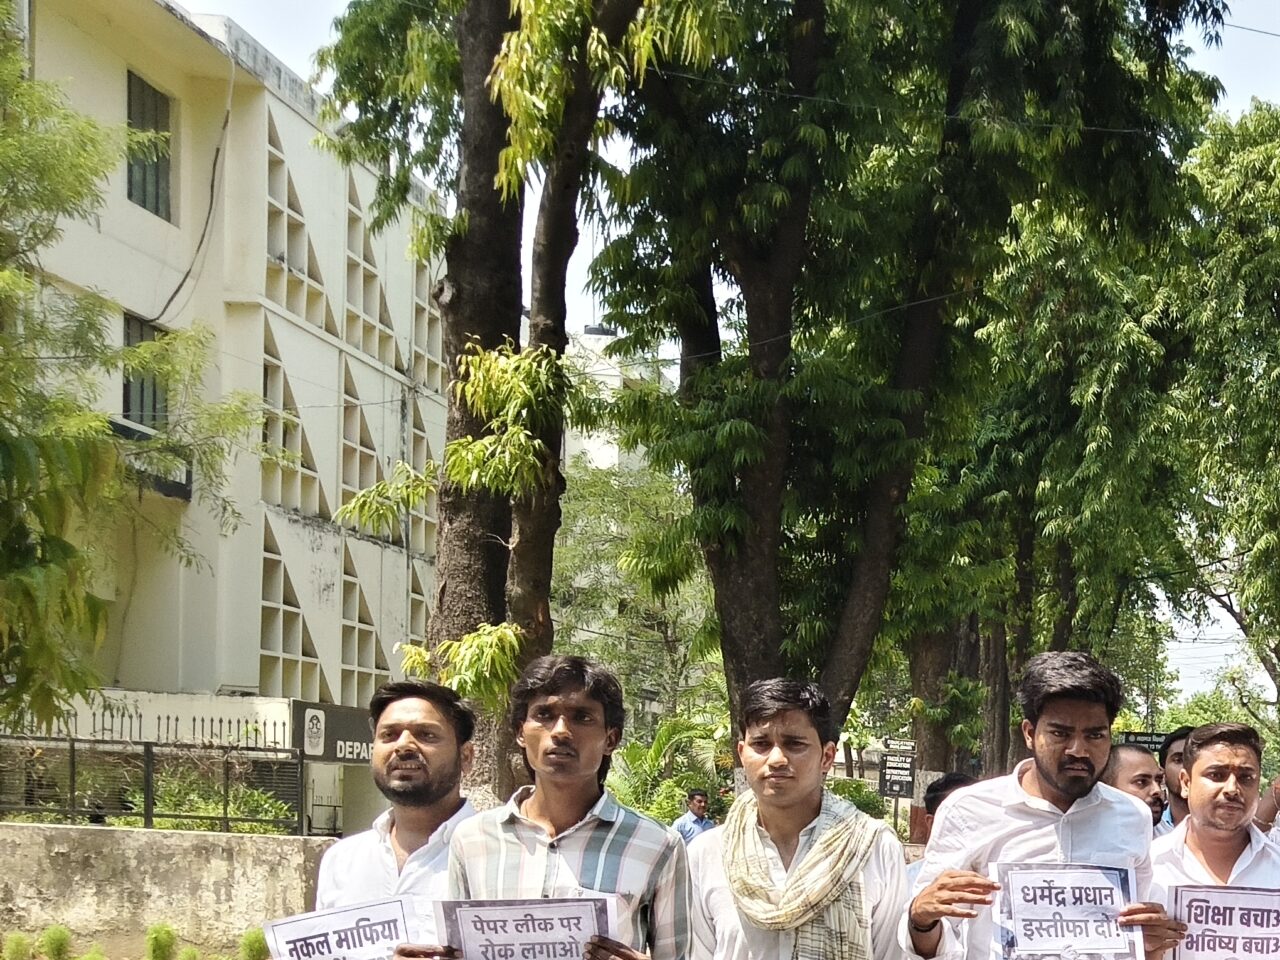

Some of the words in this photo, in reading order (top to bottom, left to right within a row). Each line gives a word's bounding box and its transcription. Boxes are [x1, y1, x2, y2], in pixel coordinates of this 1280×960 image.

[1021, 880, 1067, 907] धर्मेंद्र
[1070, 886, 1114, 906] प्रधान
[471, 914, 508, 935] पेपर
[512, 913, 554, 934] लीक
[558, 916, 582, 932] पर
[1186, 898, 1235, 926] शिक्षा
[285, 932, 332, 960] नकल
[332, 918, 400, 950] माफिया
[1022, 911, 1089, 941] इस्तीफा
[1093, 913, 1121, 939] दो!
[479, 938, 515, 960] रोक
[1185, 928, 1239, 953] भविष्य
